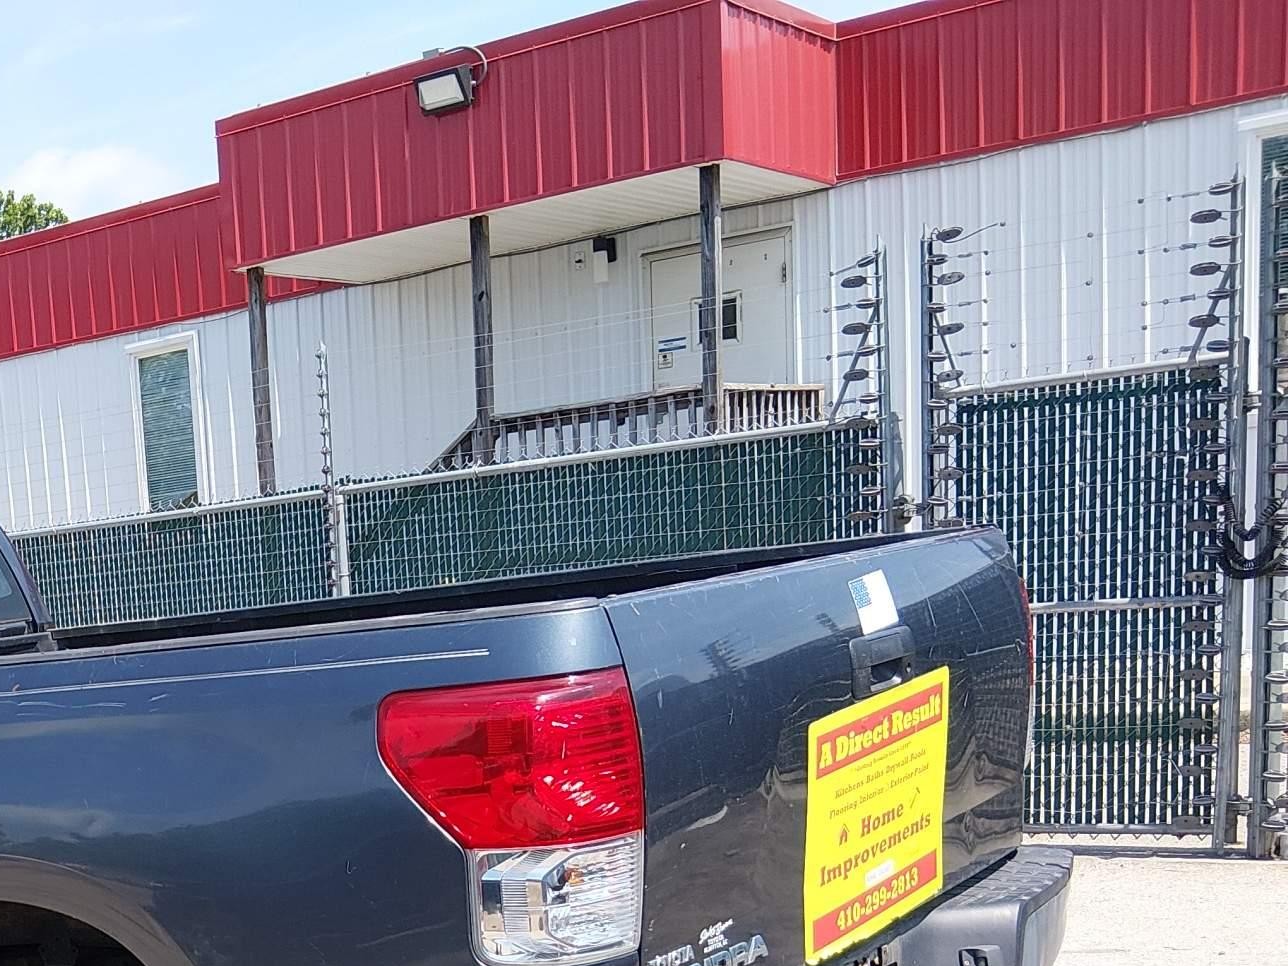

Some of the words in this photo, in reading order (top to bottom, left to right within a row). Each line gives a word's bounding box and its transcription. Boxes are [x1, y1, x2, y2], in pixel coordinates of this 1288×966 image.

[818, 741, 832, 770] A
[835, 716, 890, 762] Direct
[891, 694, 940, 735] Result
[819, 813, 931, 888] Improvements
[860, 803, 904, 838] Home
[835, 867, 919, 931] 410-299-2813
